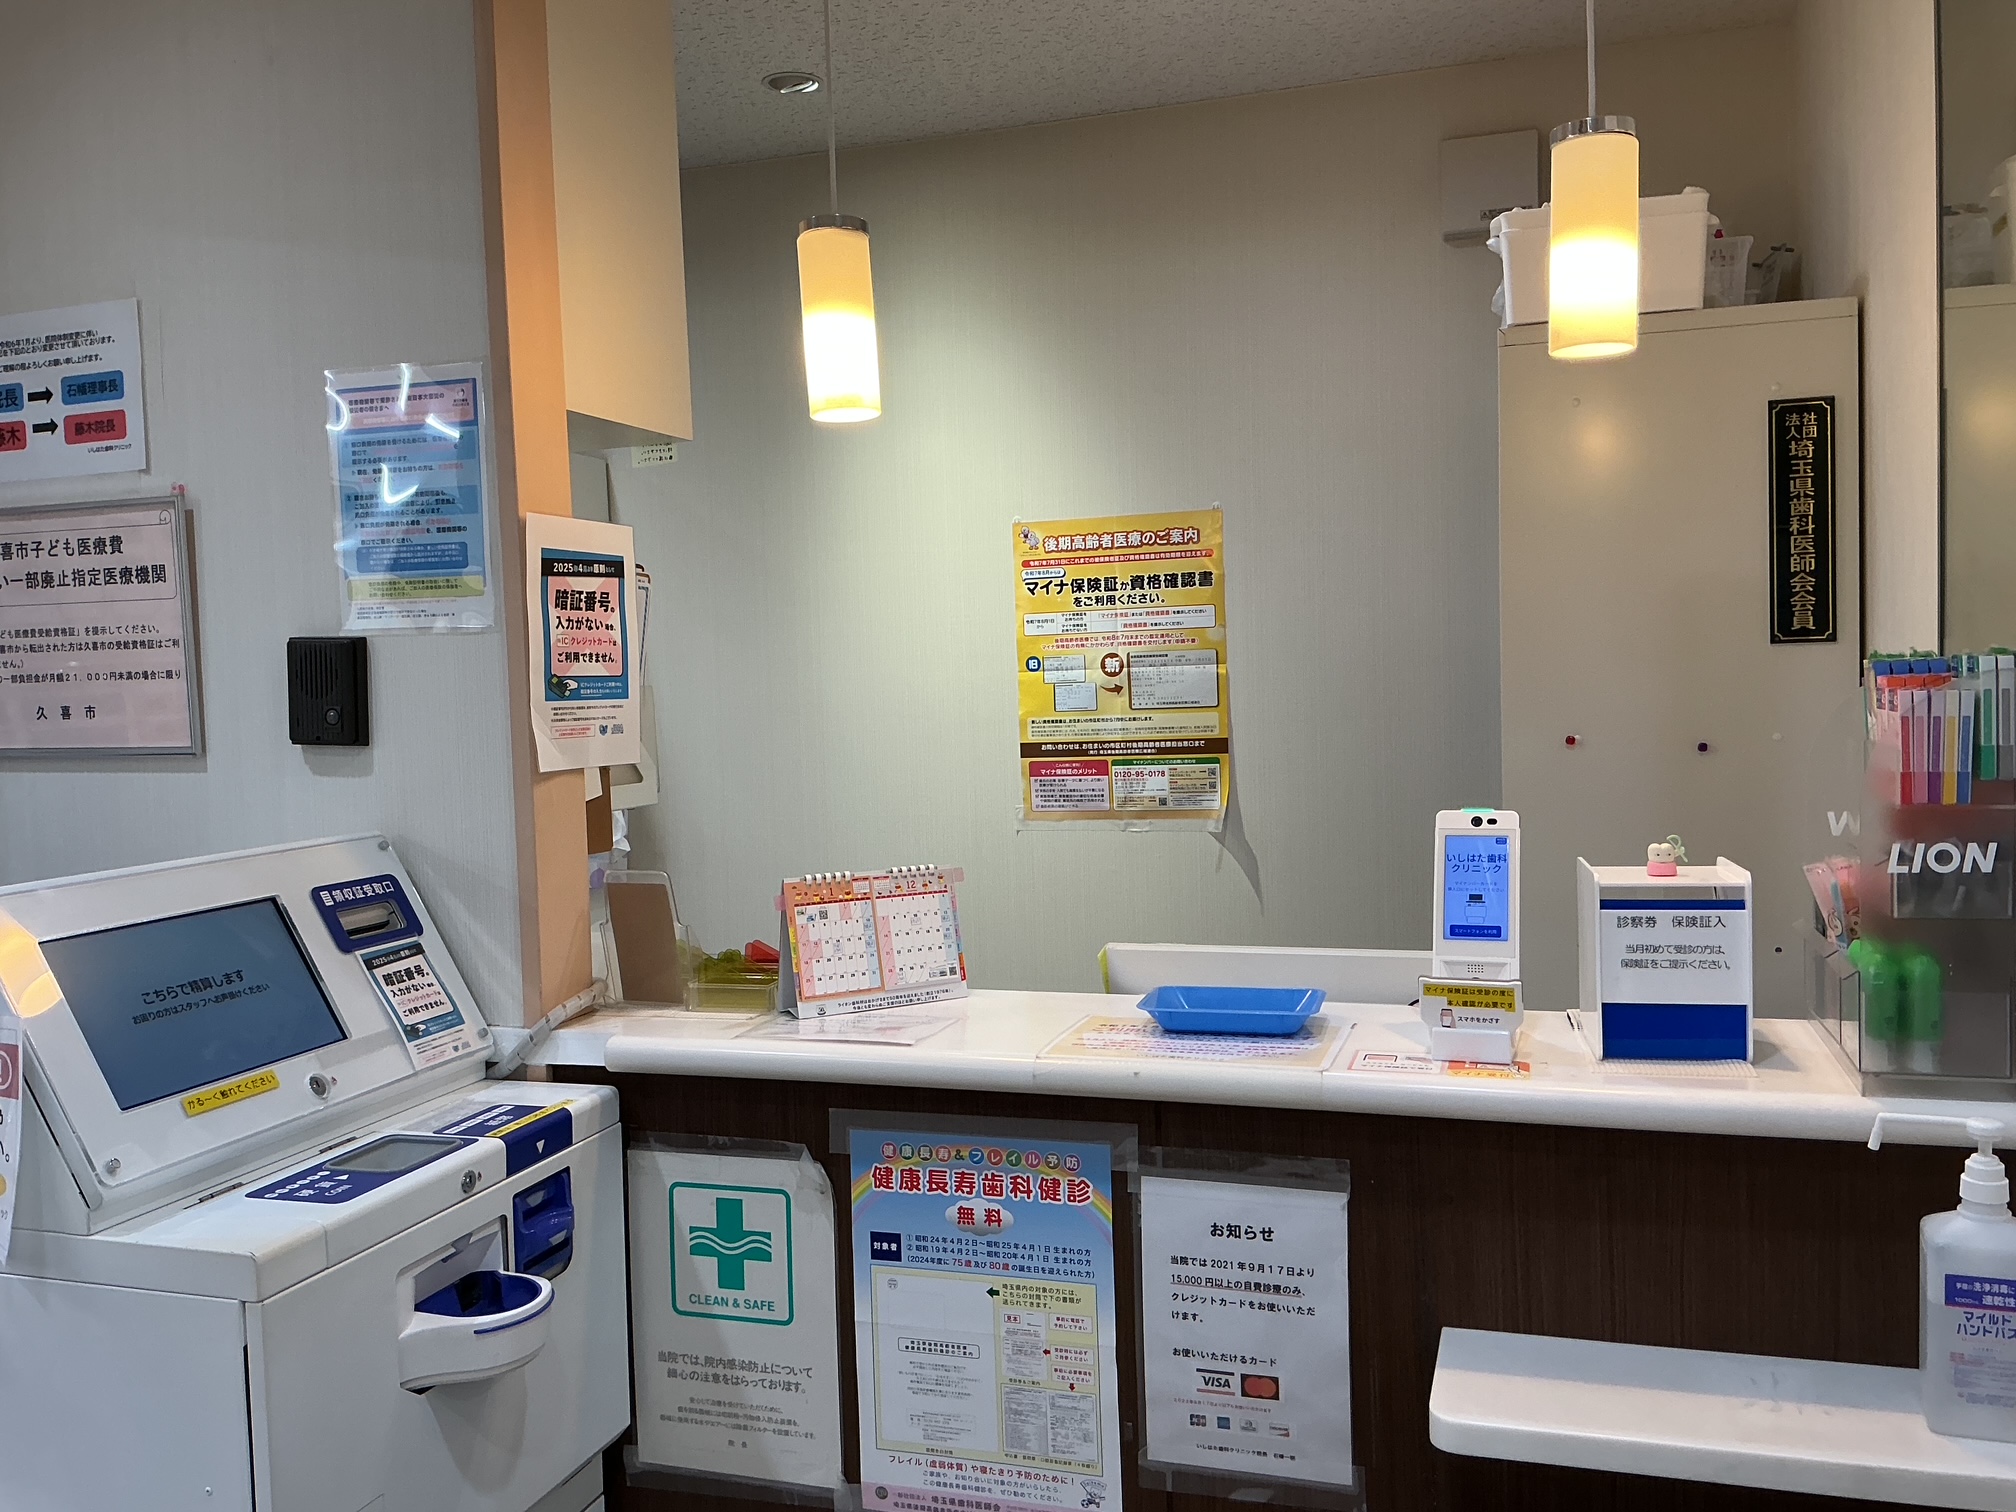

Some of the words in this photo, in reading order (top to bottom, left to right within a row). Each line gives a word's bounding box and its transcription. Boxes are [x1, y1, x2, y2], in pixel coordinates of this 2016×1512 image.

[74, 418, 116, 436] 藤木院長
[1043, 527, 1199, 552] 後期高齢者医療のご案内
[1788, 439, 1817, 631] 埼玉県歯科医師会会員
[1024, 571, 1214, 596] マイナ保険証か資格確認書
[1072, 592, 1166, 608] をご利用ください。
[557, 651, 618, 664] ご利用できません。
[1028, 660, 1039, 670] 旧
[1103, 656, 1121, 674] 新
[1113, 770, 1166, 778] 0120-95-0178
[1446, 853, 1508, 864] いしはた歯科
[1887, 842, 1998, 874] LION
[1451, 863, 1502, 874] クリニック
[332, 881, 395, 903] 領収証受取口
[906, 880, 917, 890] 12
[1616, 915, 1658, 929] 診察券
[1671, 915, 1727, 929] 保険証入
[1625, 943, 1726, 955] 当月初めて受診の方は、
[1620, 958, 1731, 971] 保険証をご提示ください。
[140, 969, 245, 1006] こちらで精算します
[1424, 986, 1514, 997] マイナ保険証は受診の度に
[402, 999, 448, 1017] ご利用できません。
[1447, 999, 1514, 1009] 本人確認が必要です
[1457, 1015, 1500, 1025] スマホをかざす
[871, 1164, 1092, 1204] 健康長寿歯科健診
[1210, 1222, 1275, 1242] お知らせ
[873, 1240, 898, 1252] 対象者
[1001, 1283, 1078, 1297] 埼玉県内の対象の方には、
[1001, 1291, 1082, 1304] こちらの封筒で下の書類が
[688, 1293, 729, 1307] CLEAN
[732, 1298, 741, 1309] &
[743, 1299, 776, 1312] SAFE
[1002, 1298, 1052, 1309] 送られてきます。
[1171, 1292, 1316, 1316] クレジットカードをお使いいただ
[1171, 1310, 1204, 1324] けます。
[1963, 1310, 2014, 1326] マイルド
[657, 1350, 813, 1378] 当院では、院内感染防止について
[1172, 1346, 1277, 1367] お使いいただけるカード
[667, 1367, 806, 1394] 細心の注意をはらっております。
[1201, 1375, 1231, 1390] VISA
